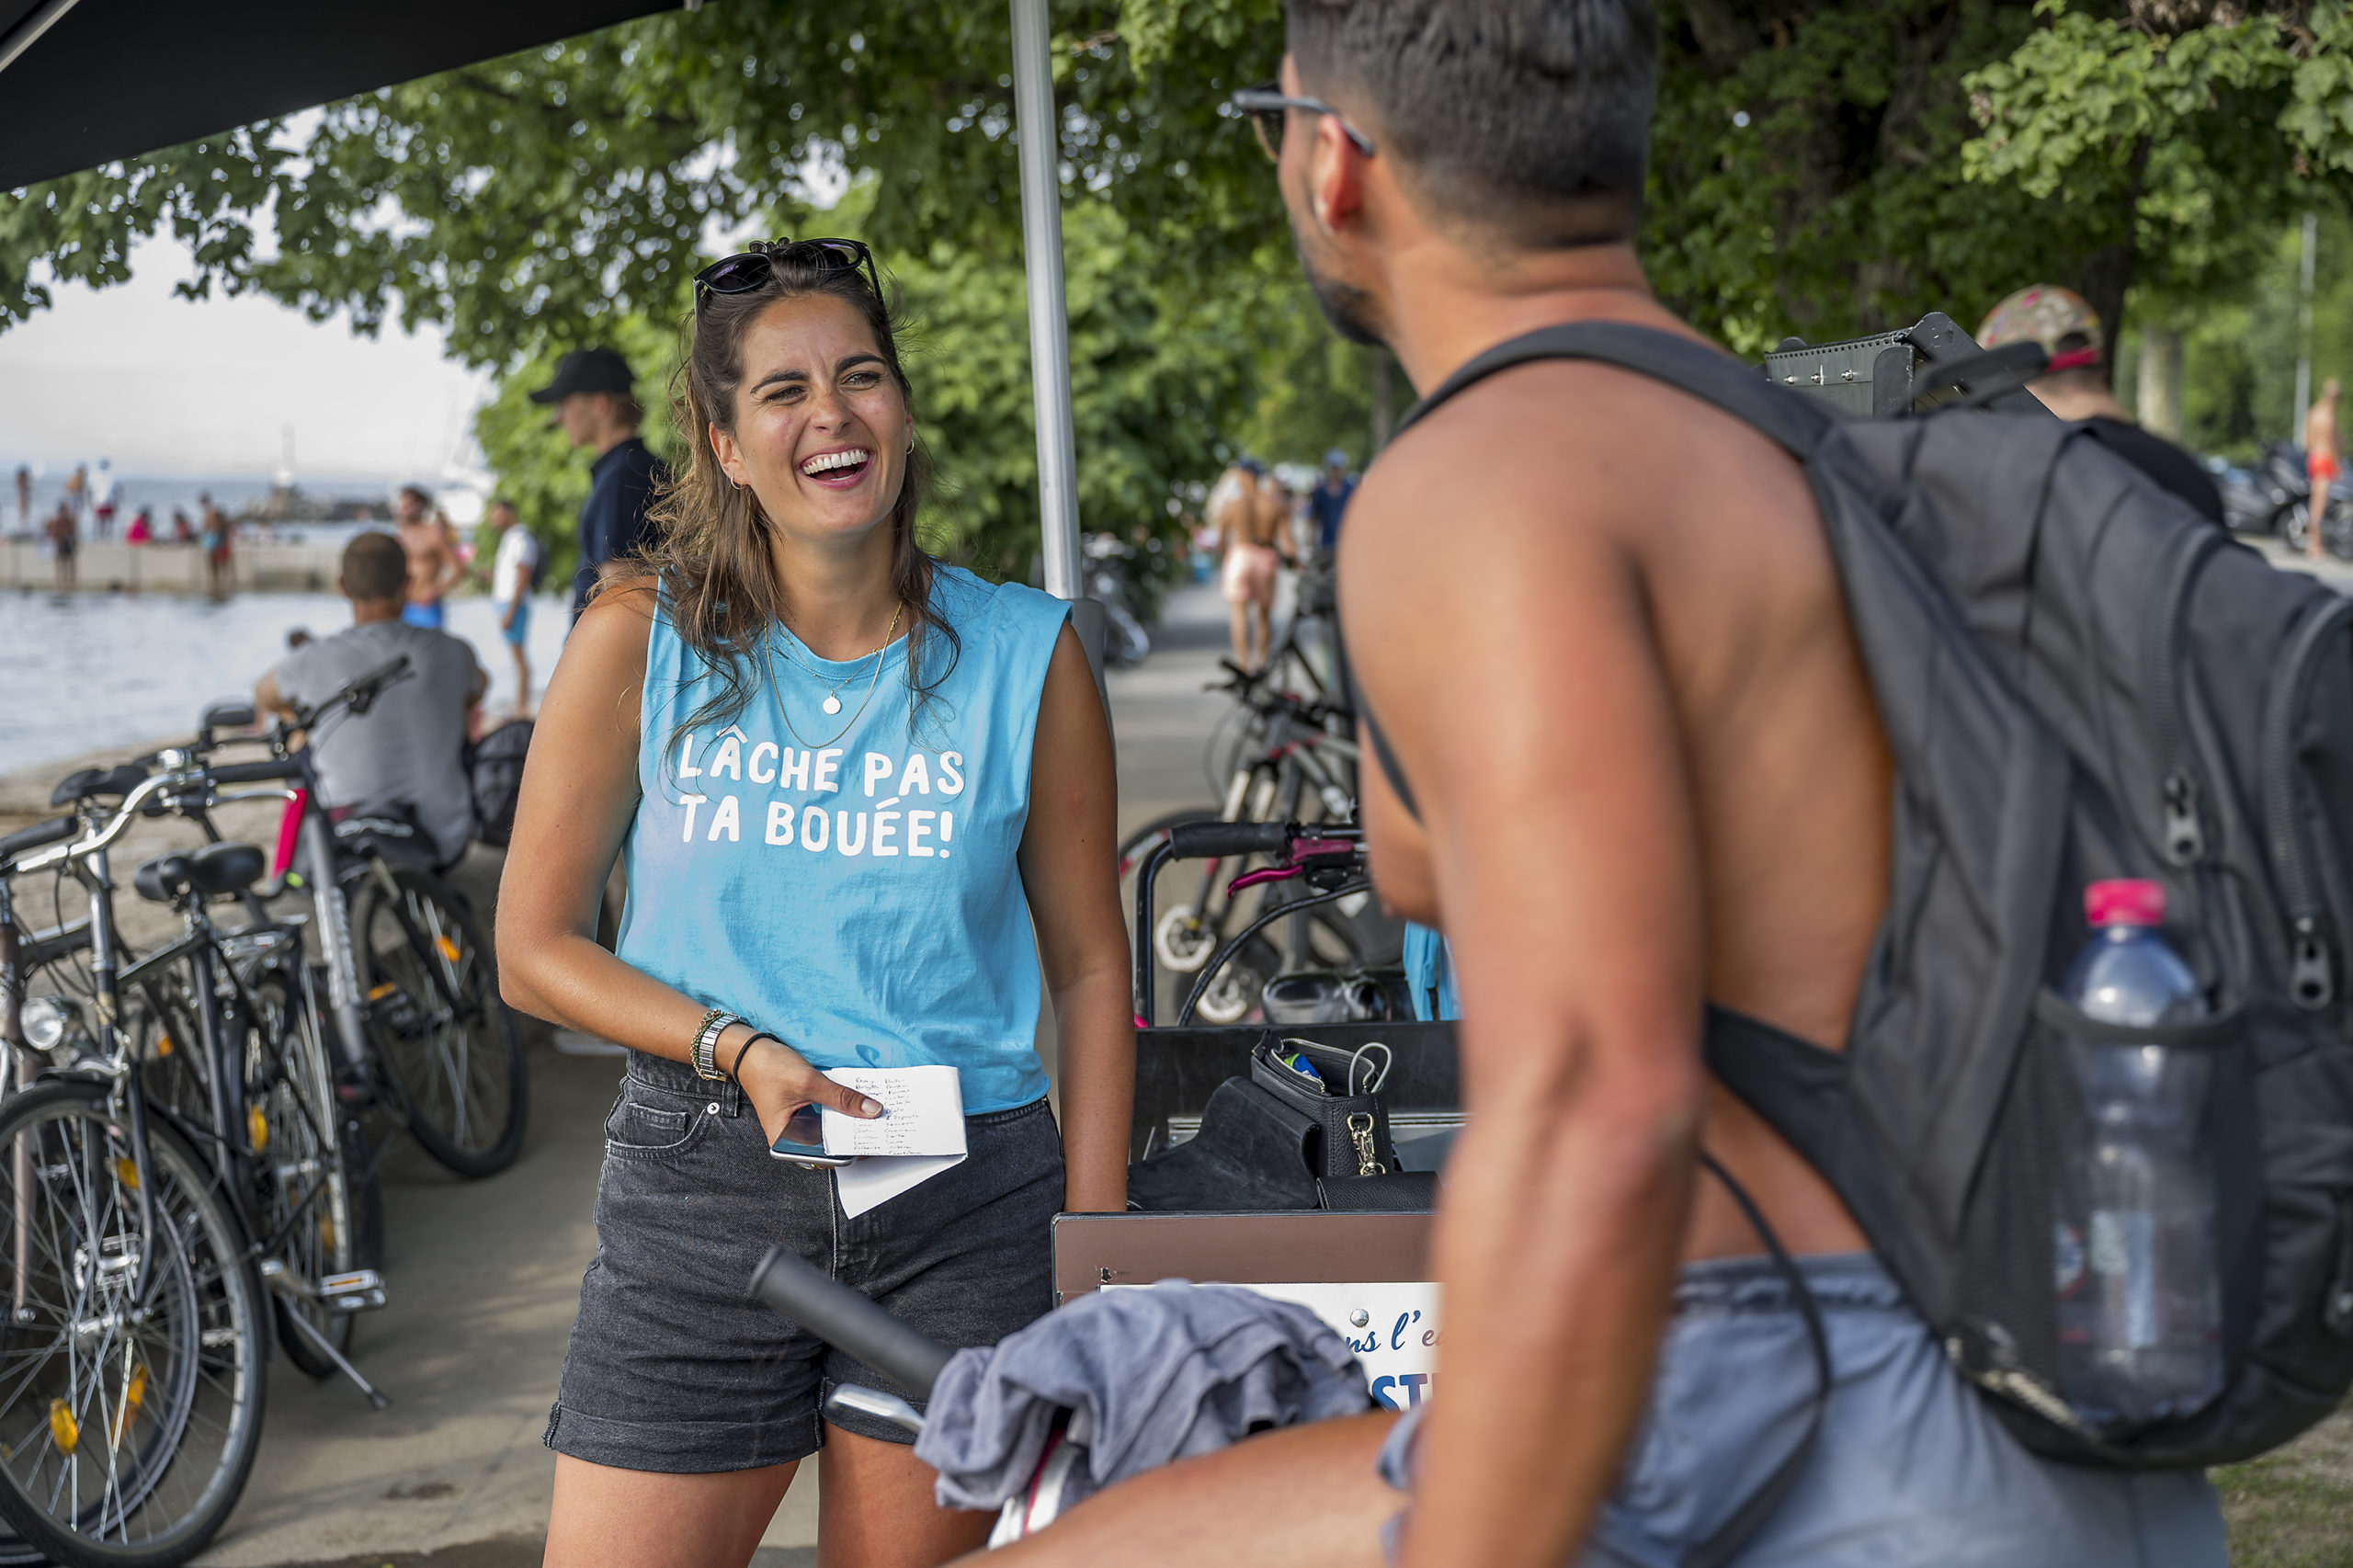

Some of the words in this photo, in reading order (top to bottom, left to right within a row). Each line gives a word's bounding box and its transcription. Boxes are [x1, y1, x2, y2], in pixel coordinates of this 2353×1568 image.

[679, 724, 844, 793] LÂCHE
[864, 750, 965, 798] PAS
[679, 795, 740, 843] TA
[765, 797, 954, 858] BOUÉE!
[1371, 1372, 1441, 1413] ST
